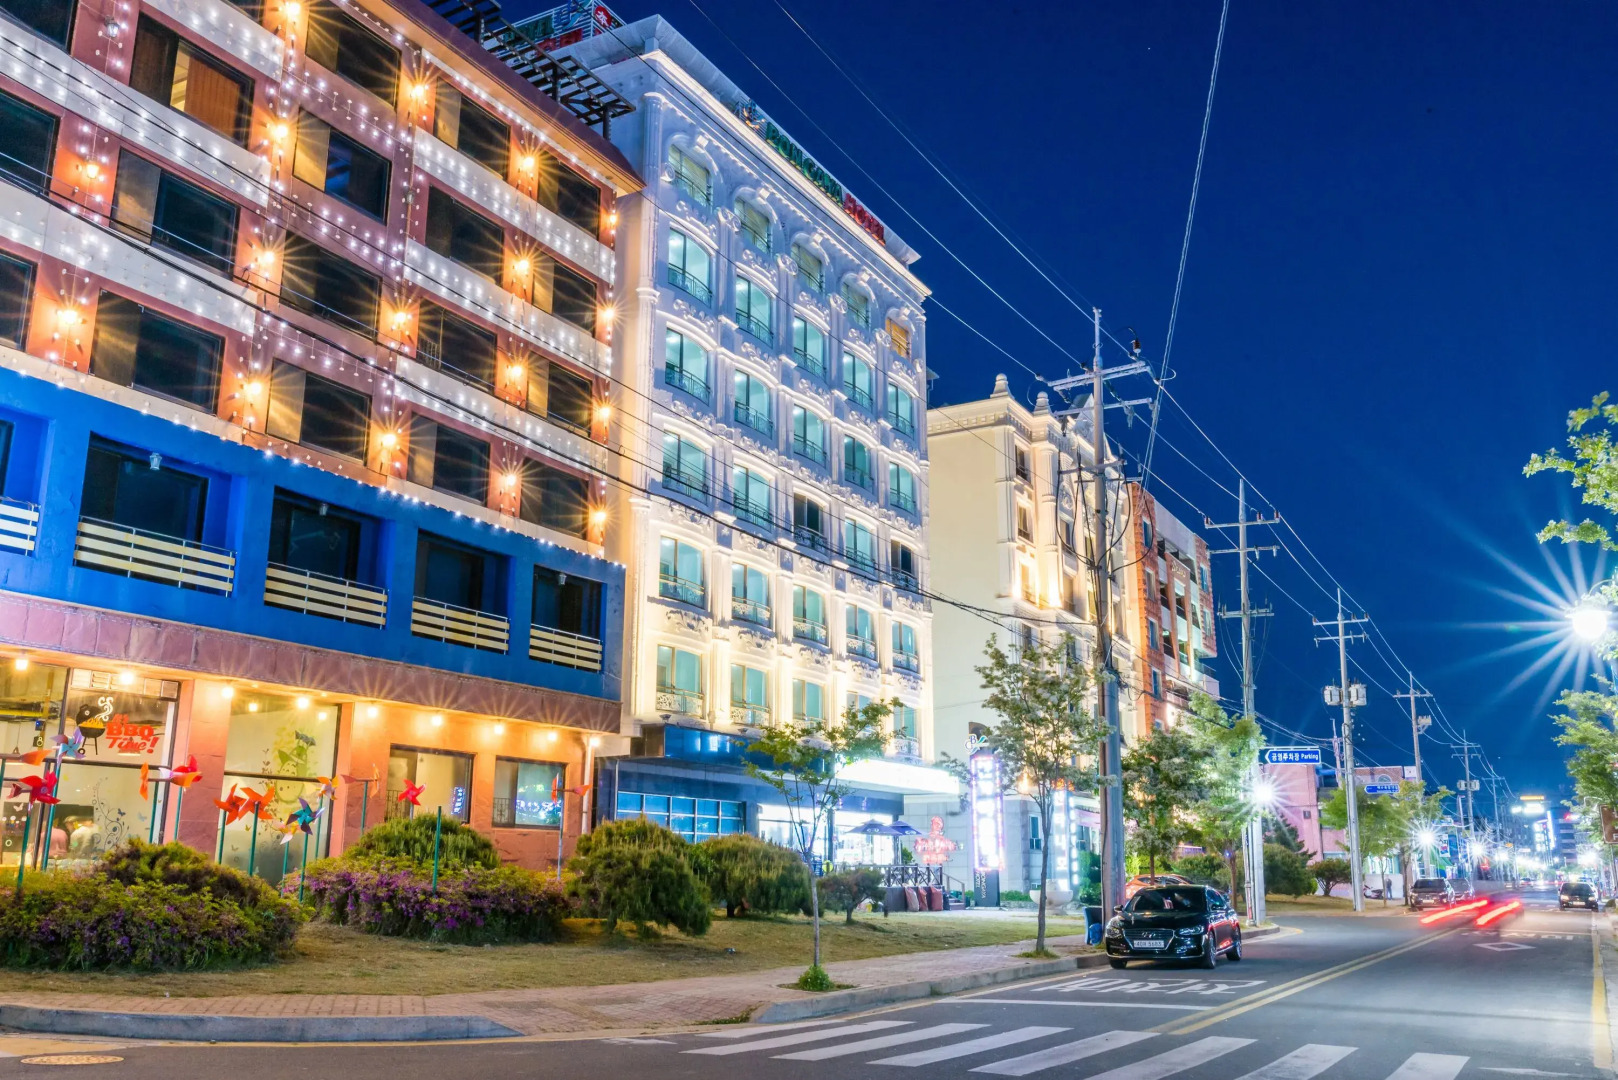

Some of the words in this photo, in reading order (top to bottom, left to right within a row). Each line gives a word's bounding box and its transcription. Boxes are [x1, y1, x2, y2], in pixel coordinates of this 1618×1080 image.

[106, 723, 154, 742] BBQ
[1271, 752, 1300, 762] 공영주차장
[1301, 753, 1319, 761] Parking
[1030, 977, 1268, 995] 천천히
